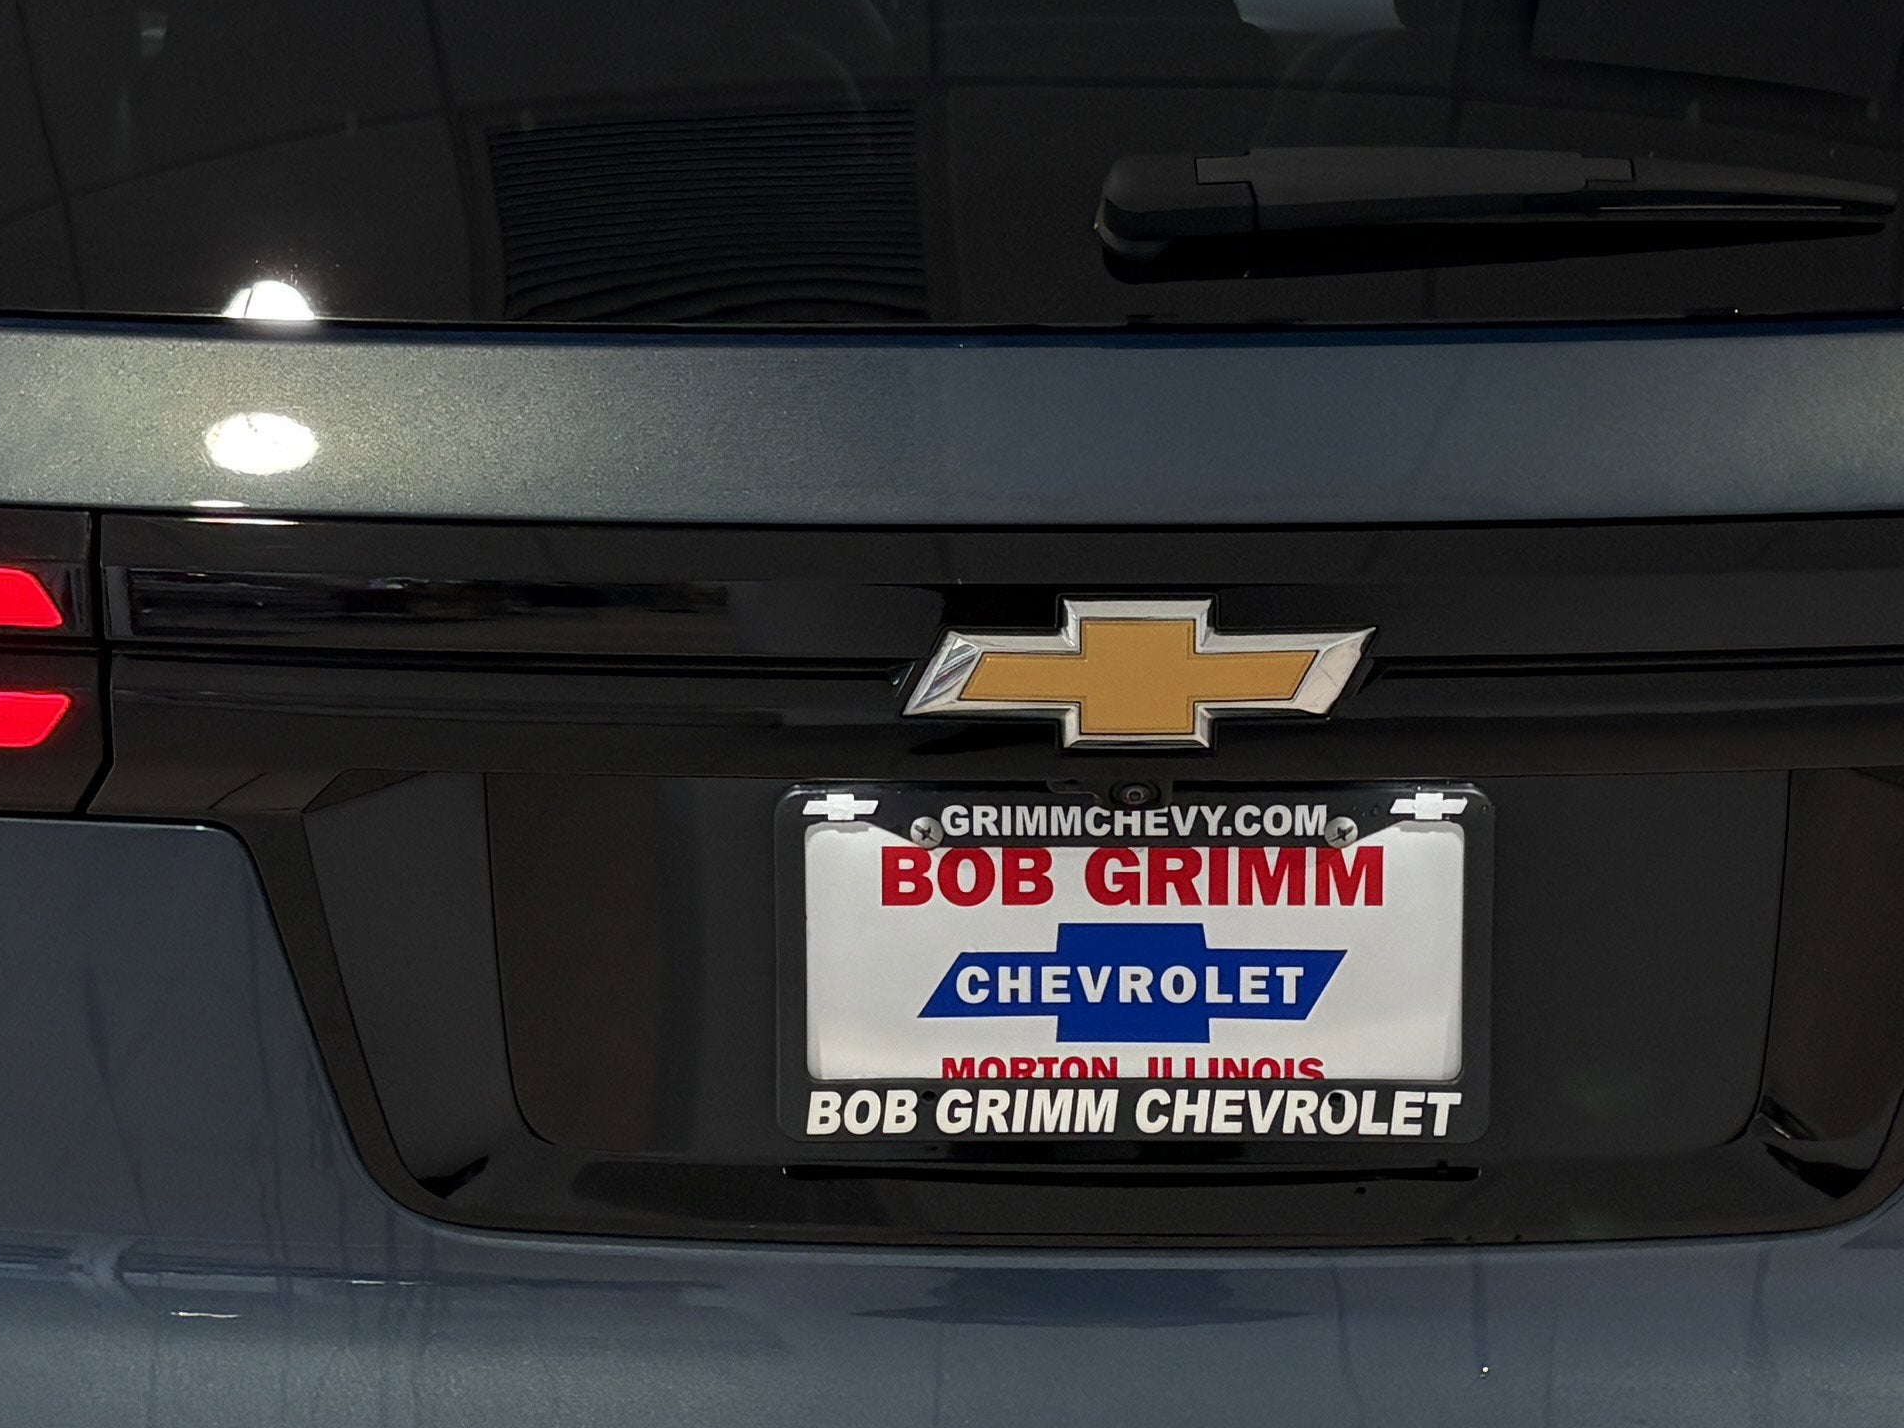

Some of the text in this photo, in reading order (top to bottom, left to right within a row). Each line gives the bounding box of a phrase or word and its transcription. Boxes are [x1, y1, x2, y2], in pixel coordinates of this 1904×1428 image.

[941, 804, 1327, 836] GRIMMCHEVY.COM
[881, 846, 1384, 907] BOB GRIMM
[956, 965, 1304, 1004] CHEVROLET
[806, 1089, 1462, 1137] BOB GRIMM CHEVROLET
